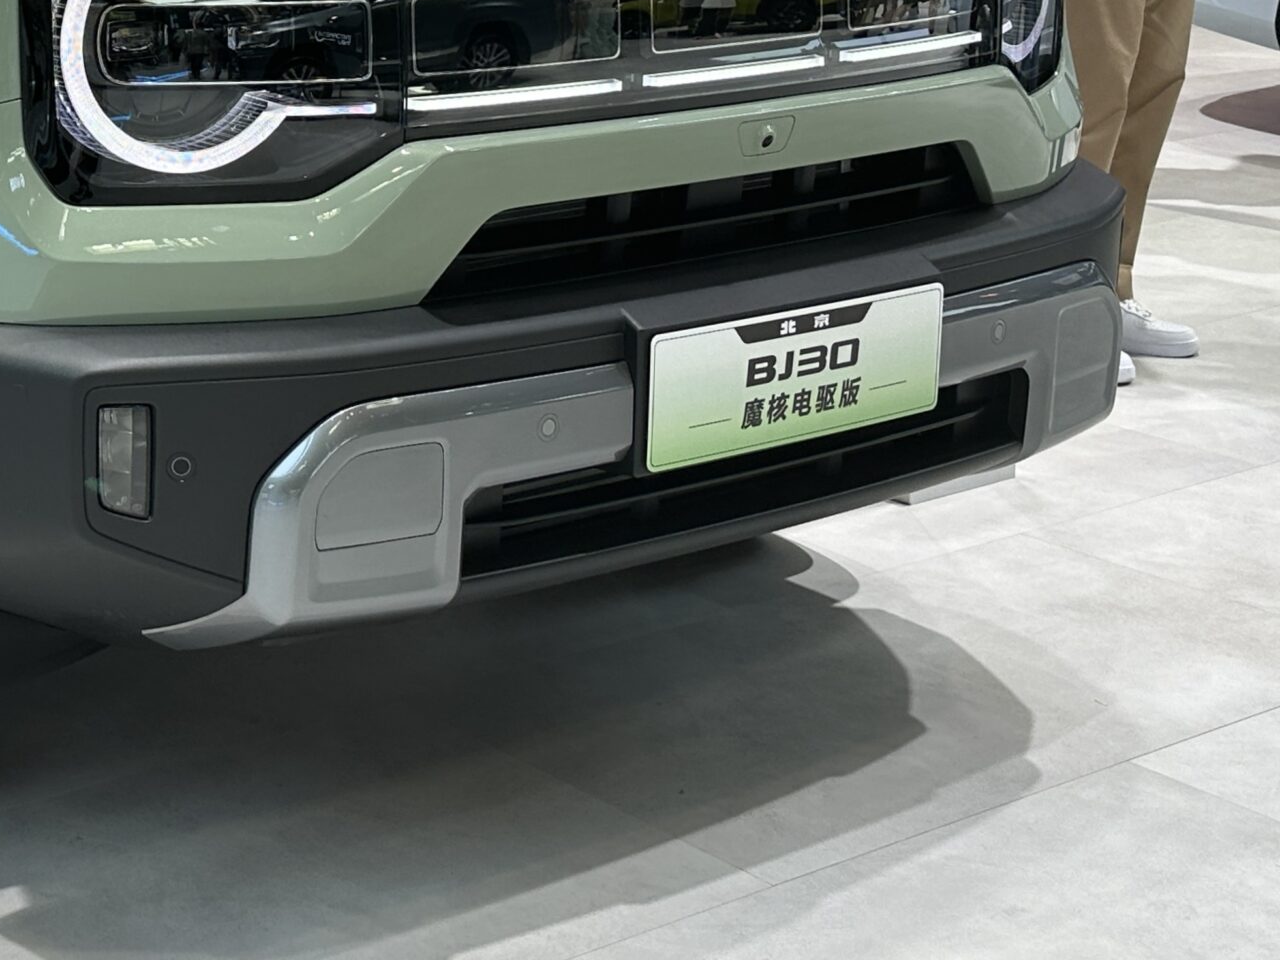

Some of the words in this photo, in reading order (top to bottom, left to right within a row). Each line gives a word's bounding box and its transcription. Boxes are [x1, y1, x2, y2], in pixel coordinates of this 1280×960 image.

[779, 313, 830, 336] 北京
[746, 338, 860, 388] BJ30
[741, 376, 862, 430] 魔核电驱版
